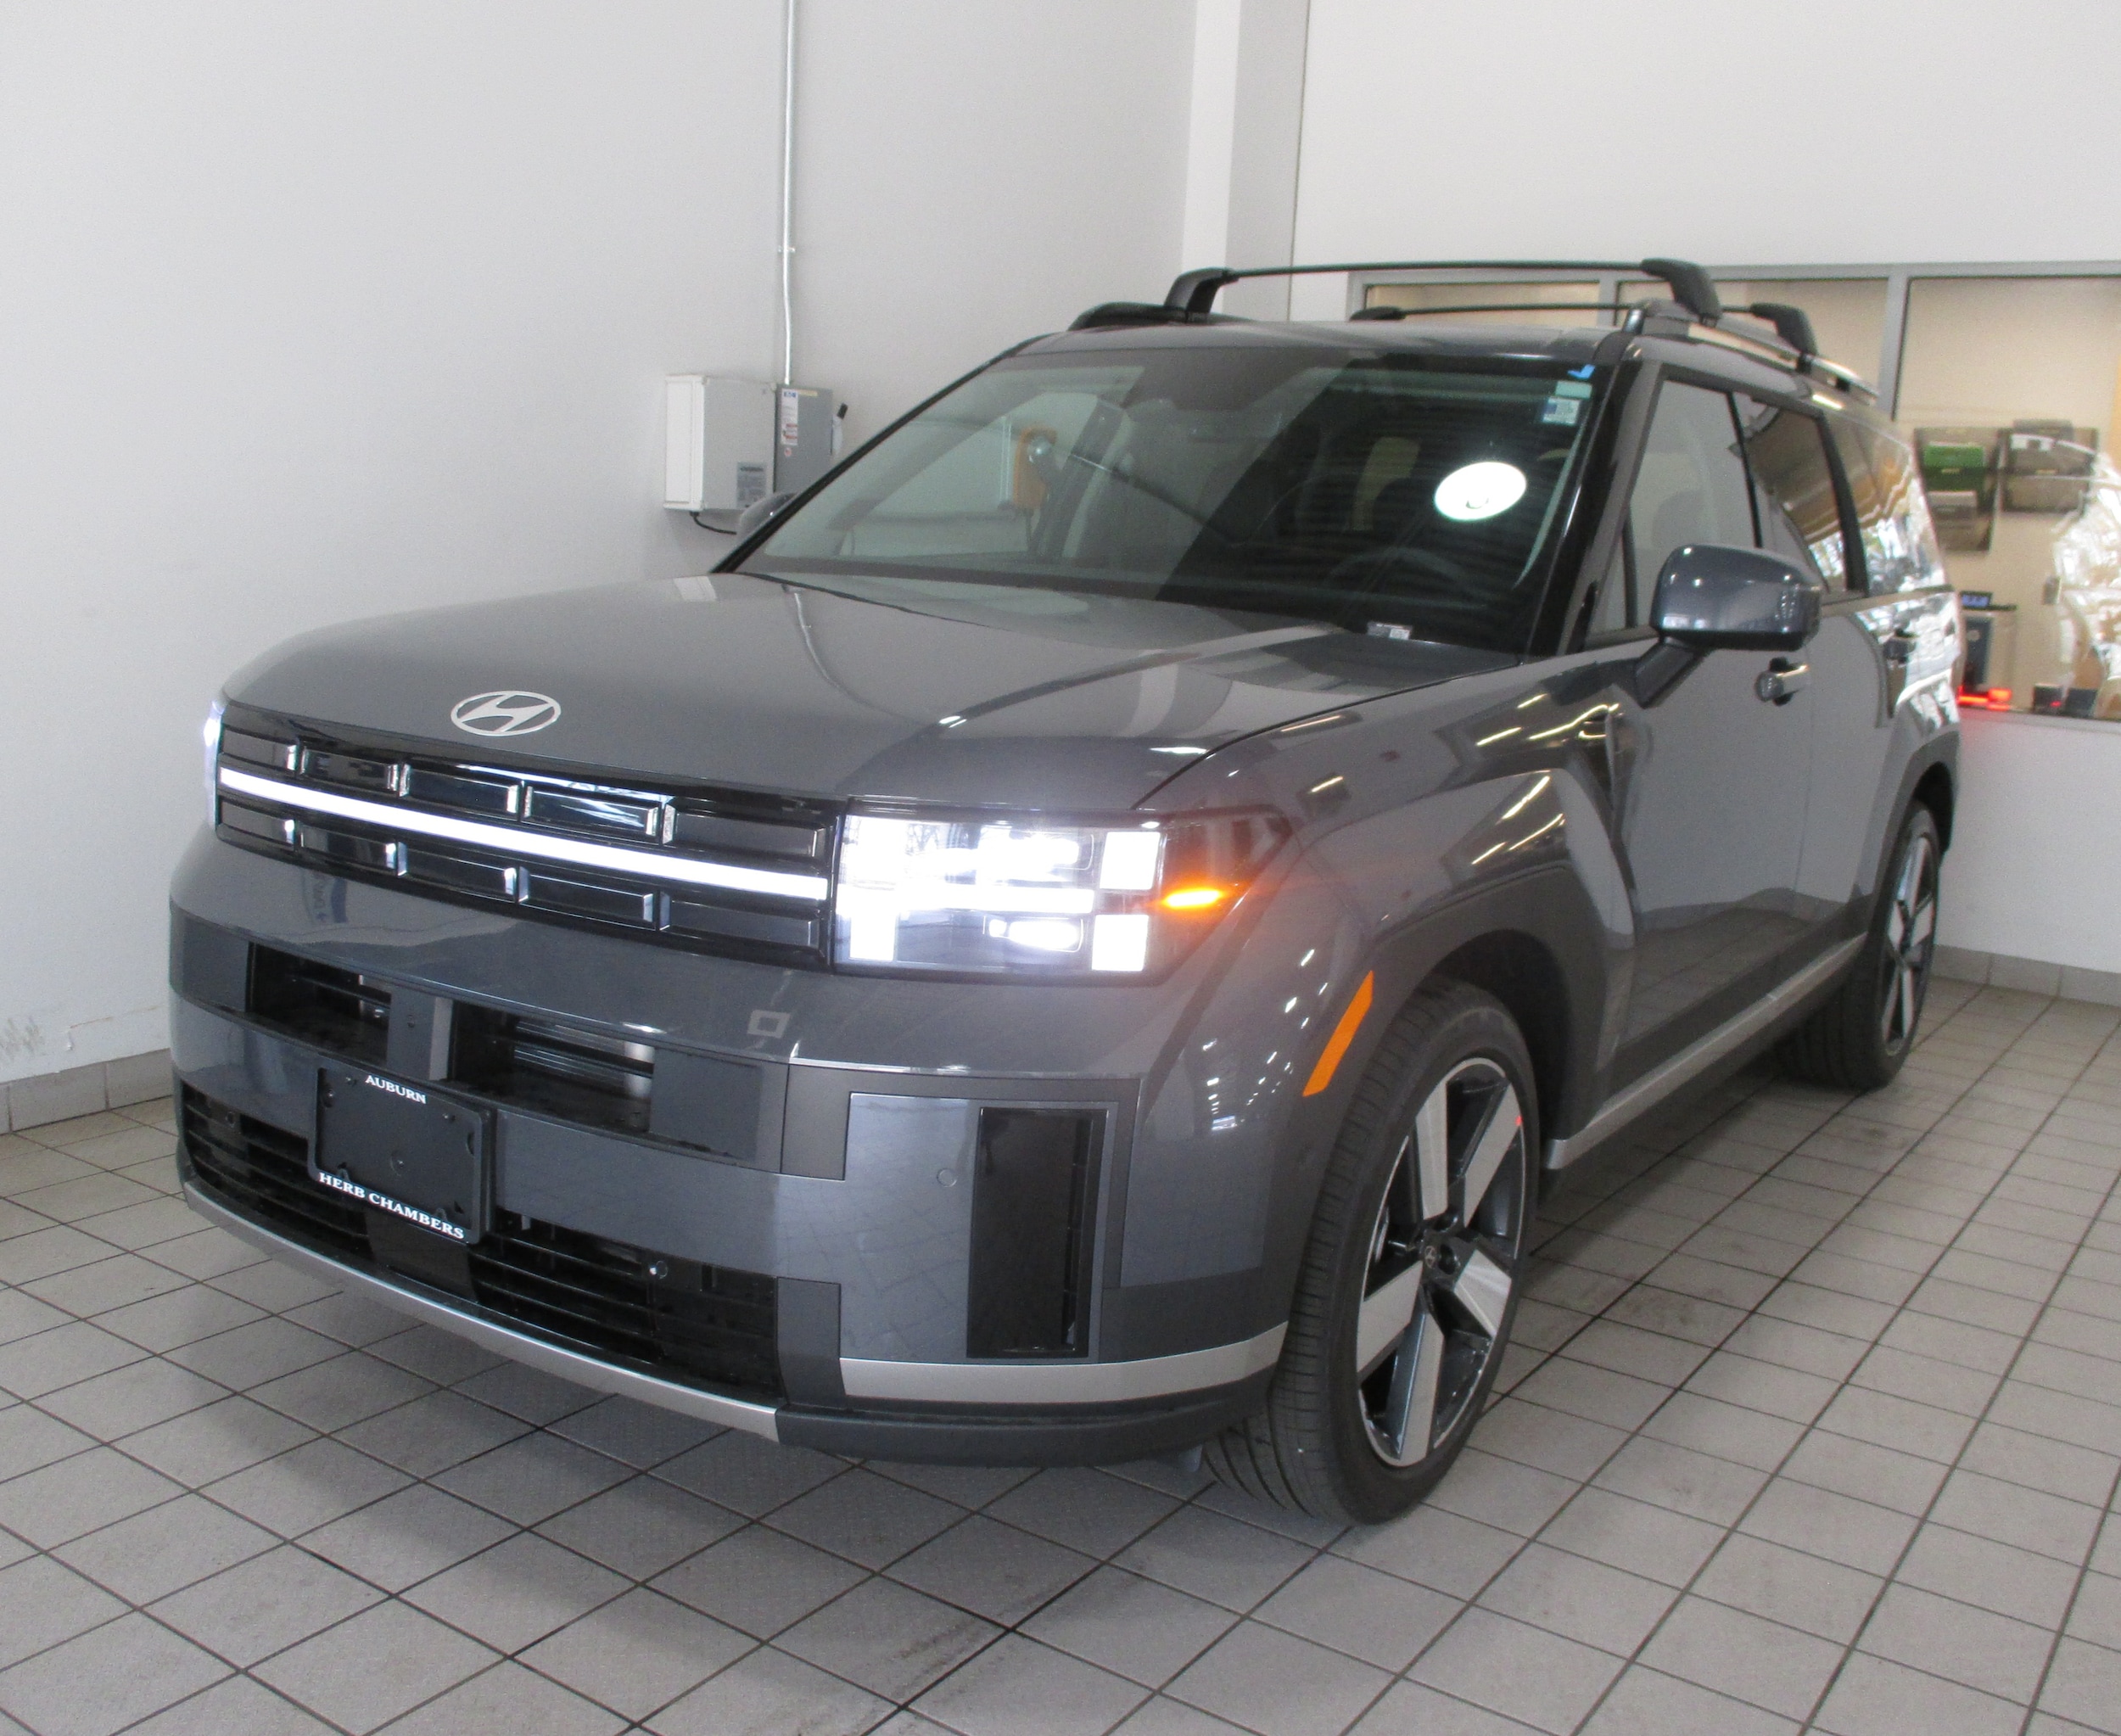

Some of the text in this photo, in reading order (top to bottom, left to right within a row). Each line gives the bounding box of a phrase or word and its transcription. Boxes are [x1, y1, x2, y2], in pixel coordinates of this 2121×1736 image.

[366, 1075, 426, 1104] AUBURN
[318, 1173, 464, 1239] HERB CHAMBERS
